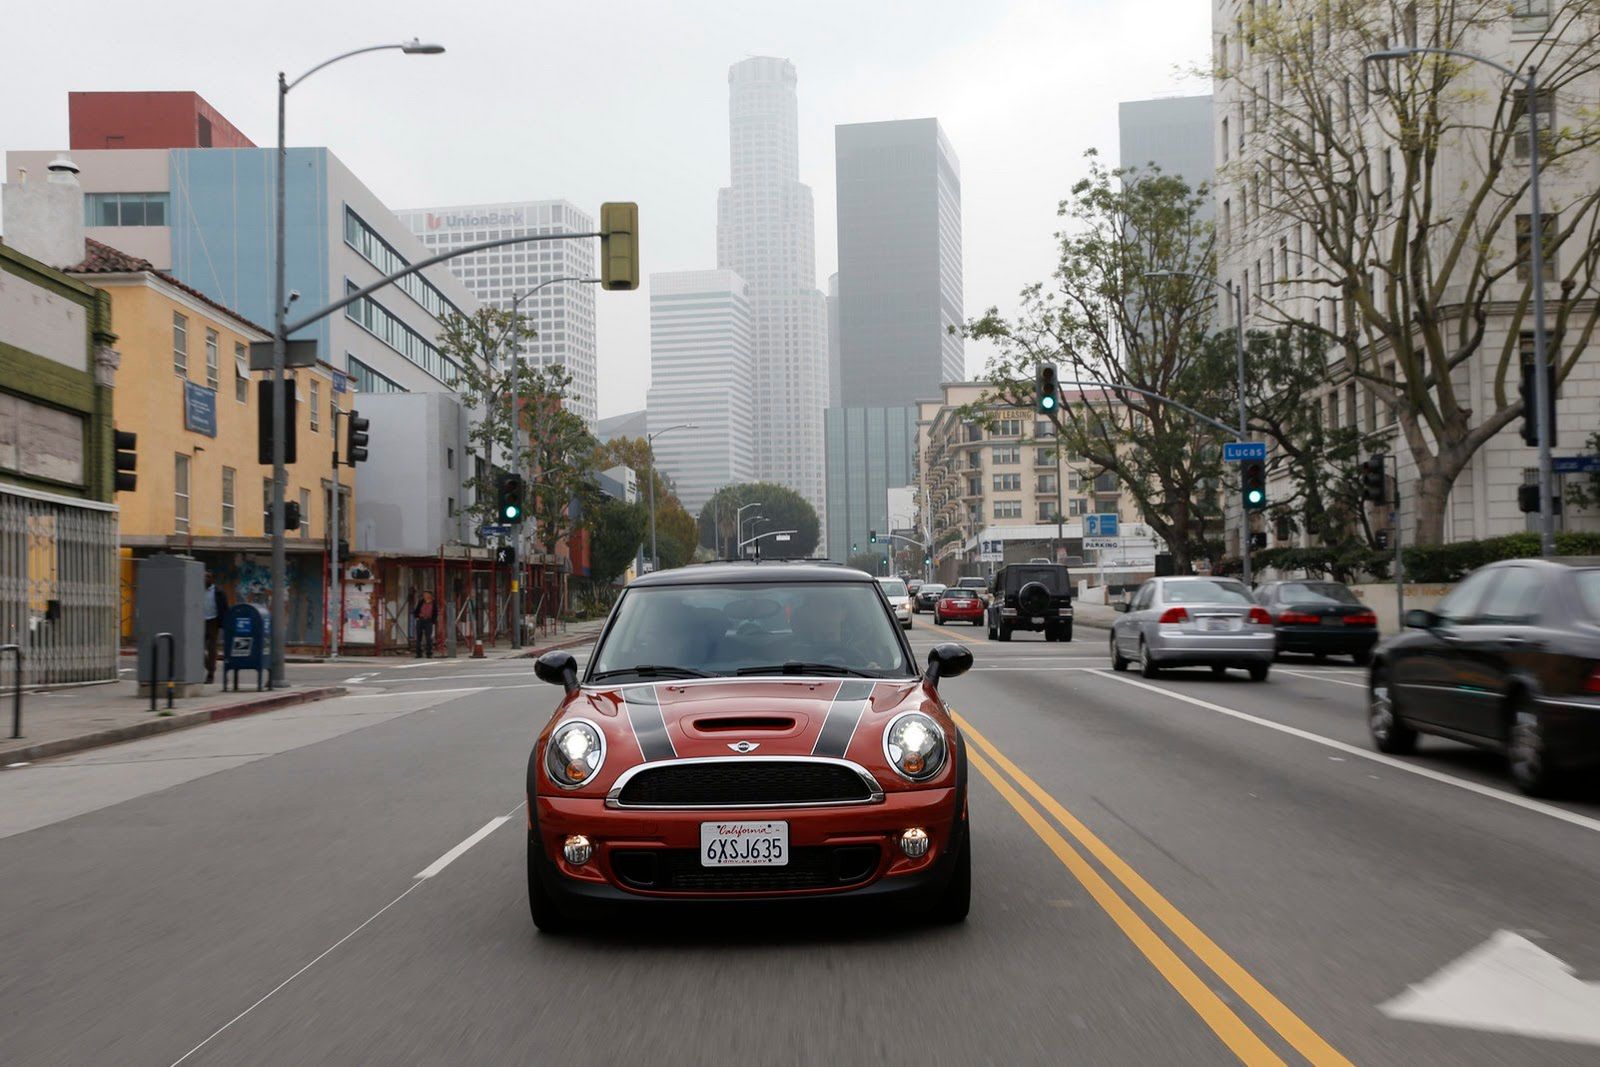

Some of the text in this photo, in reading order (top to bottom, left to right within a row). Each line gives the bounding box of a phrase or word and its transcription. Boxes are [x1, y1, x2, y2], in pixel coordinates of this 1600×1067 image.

[446, 211, 524, 227] UnionBank
[1003, 409, 1033, 420] LEASING
[1228, 447, 1263, 457] Lucas
[719, 824, 771, 837] California
[707, 838, 782, 860] 6XSJ635
